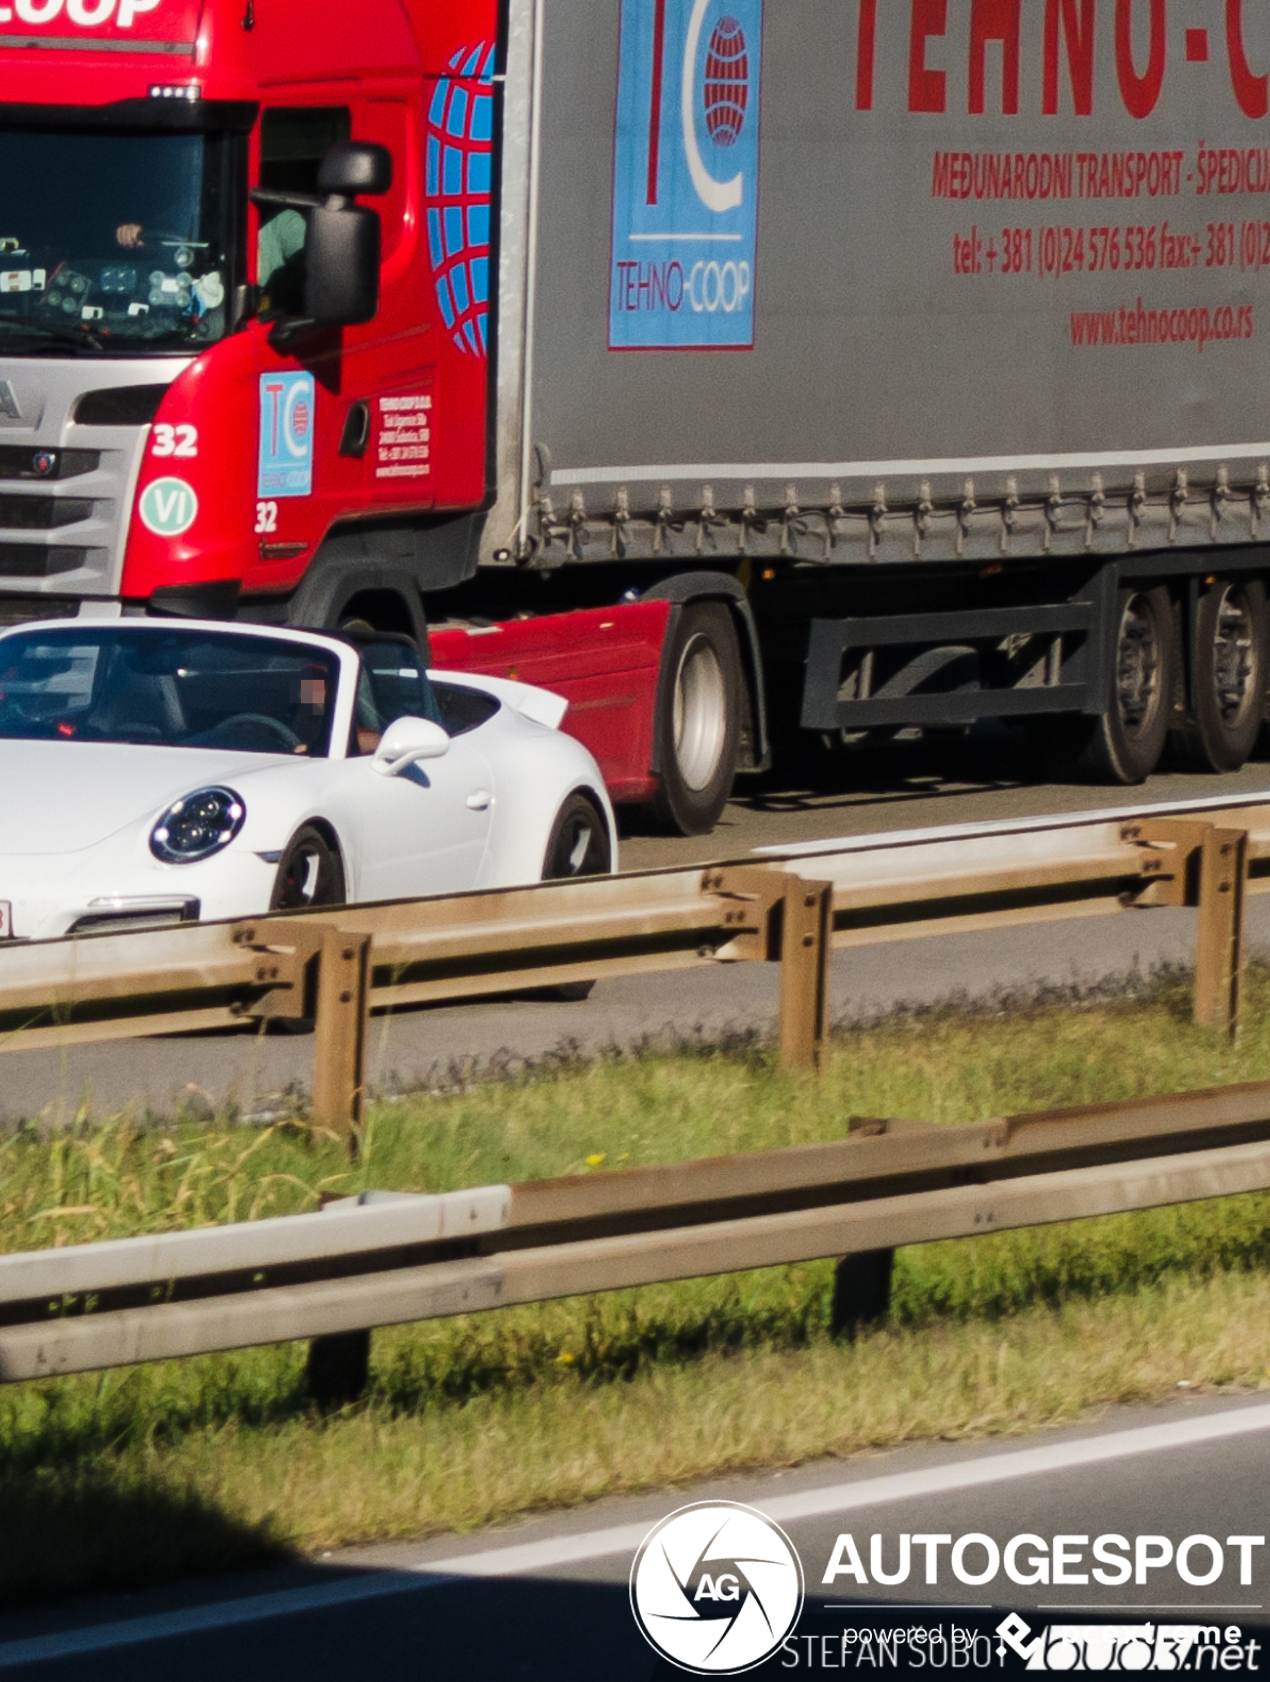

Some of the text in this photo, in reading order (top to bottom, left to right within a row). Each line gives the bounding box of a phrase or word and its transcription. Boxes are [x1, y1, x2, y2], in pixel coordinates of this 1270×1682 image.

[932, 151, 1073, 199] MEĐUNARODNI
[1076, 151, 1184, 198] TRANSPORT
[1196, 139, 1270, 196] ŠPEDICIJ
[953, 225, 982, 275] tel:
[1001, 227, 1032, 274] 381
[1037, 225, 1085, 280] (0)24
[1088, 225, 1121, 273] 576
[1124, 224, 1157, 271] 536
[1205, 222, 1234, 267] 381
[617, 260, 750, 313] TEHNO-COOP
[1071, 296, 1253, 353] www.tehnocoop.co.rs
[151, 423, 198, 457] 32
[266, 380, 309, 458] TC
[153, 488, 187, 525] VI
[254, 501, 277, 533] 32
